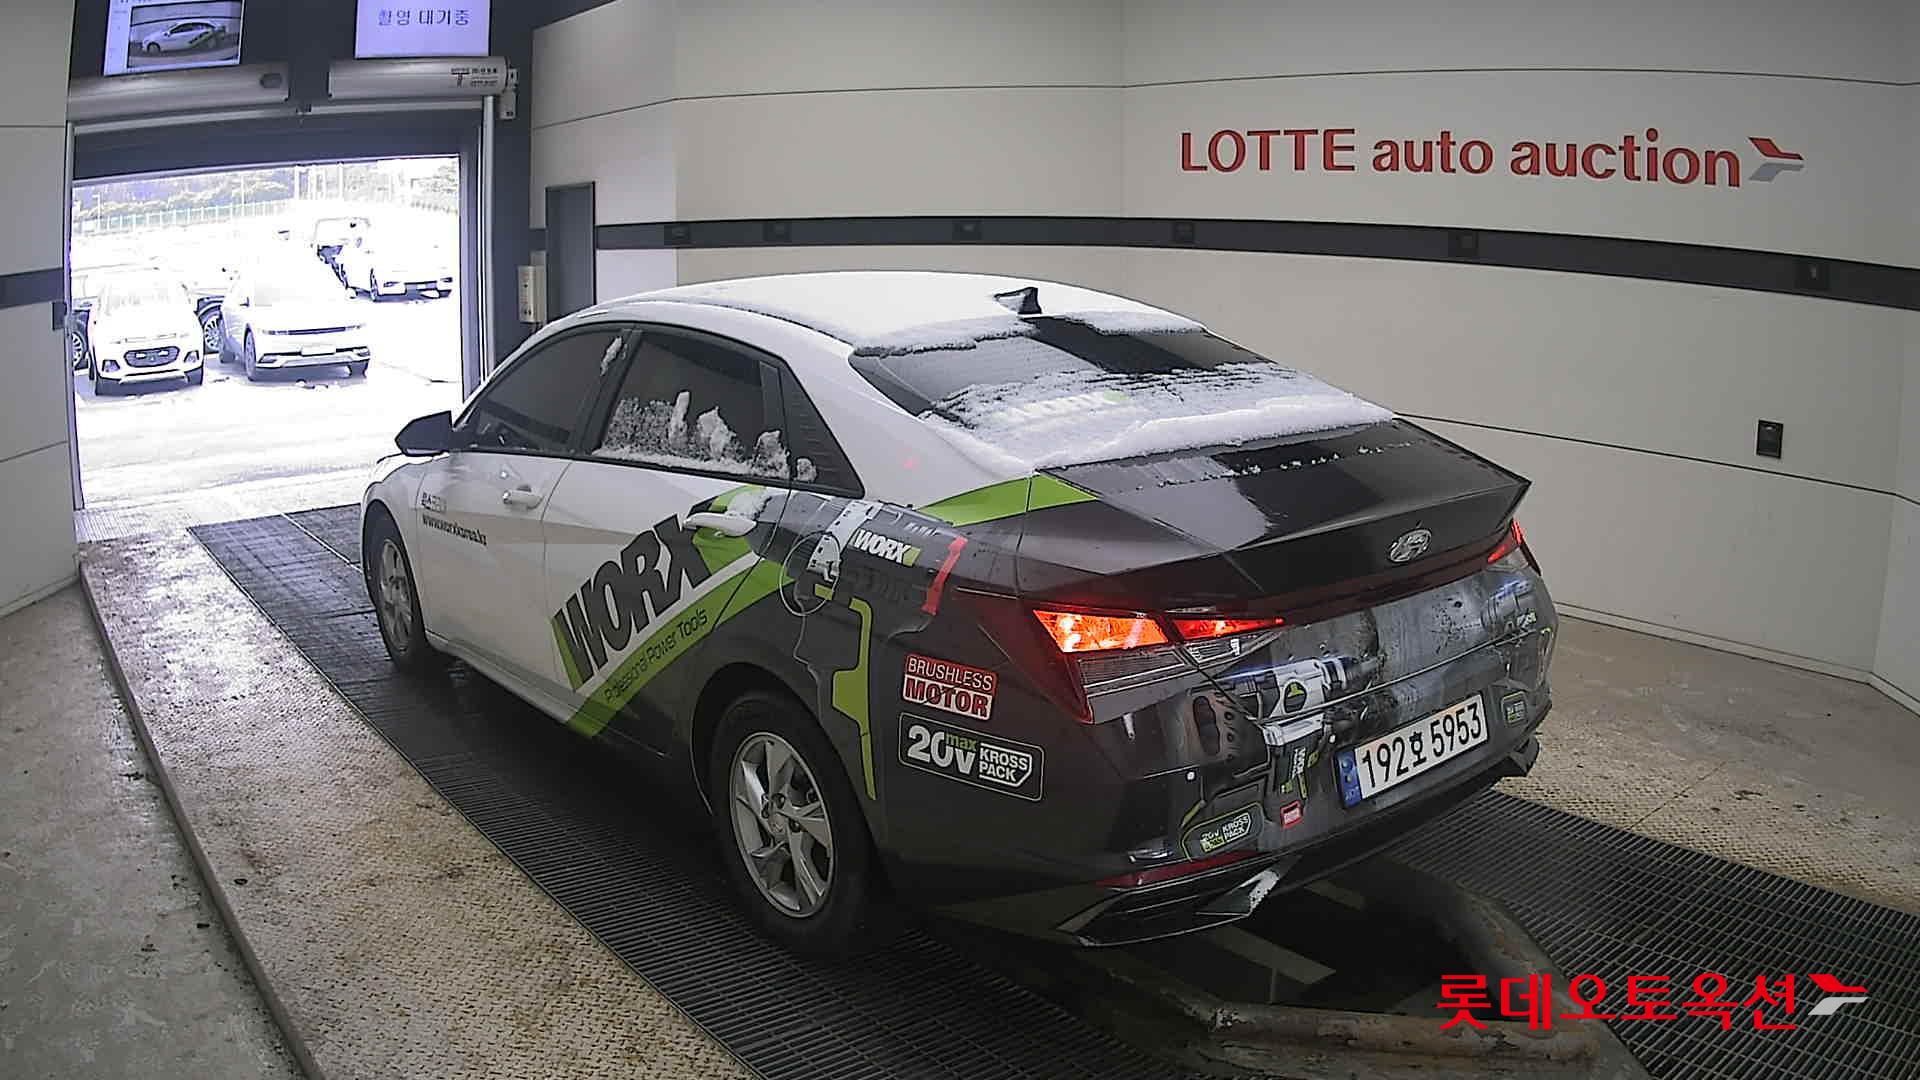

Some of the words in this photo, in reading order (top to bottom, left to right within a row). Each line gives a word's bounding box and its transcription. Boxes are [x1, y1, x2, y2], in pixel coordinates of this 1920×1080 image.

[419, 9, 470, 26] 대기중
[1181, 128, 1356, 173] LOTTE
[1372, 130, 1494, 174] auto
[1510, 127, 1741, 188] auction
[852, 528, 912, 564] WORX
[552, 495, 718, 684] WORX
[646, 631, 679, 664] Power
[678, 607, 708, 639] Tools
[907, 656, 993, 691] BRUSHLESS
[905, 678, 988, 718] MOTOR
[945, 733, 977, 751] max
[1430, 702, 1482, 758] 5953
[979, 747, 1029, 772] KROSS
[979, 761, 1017, 782] PACK
